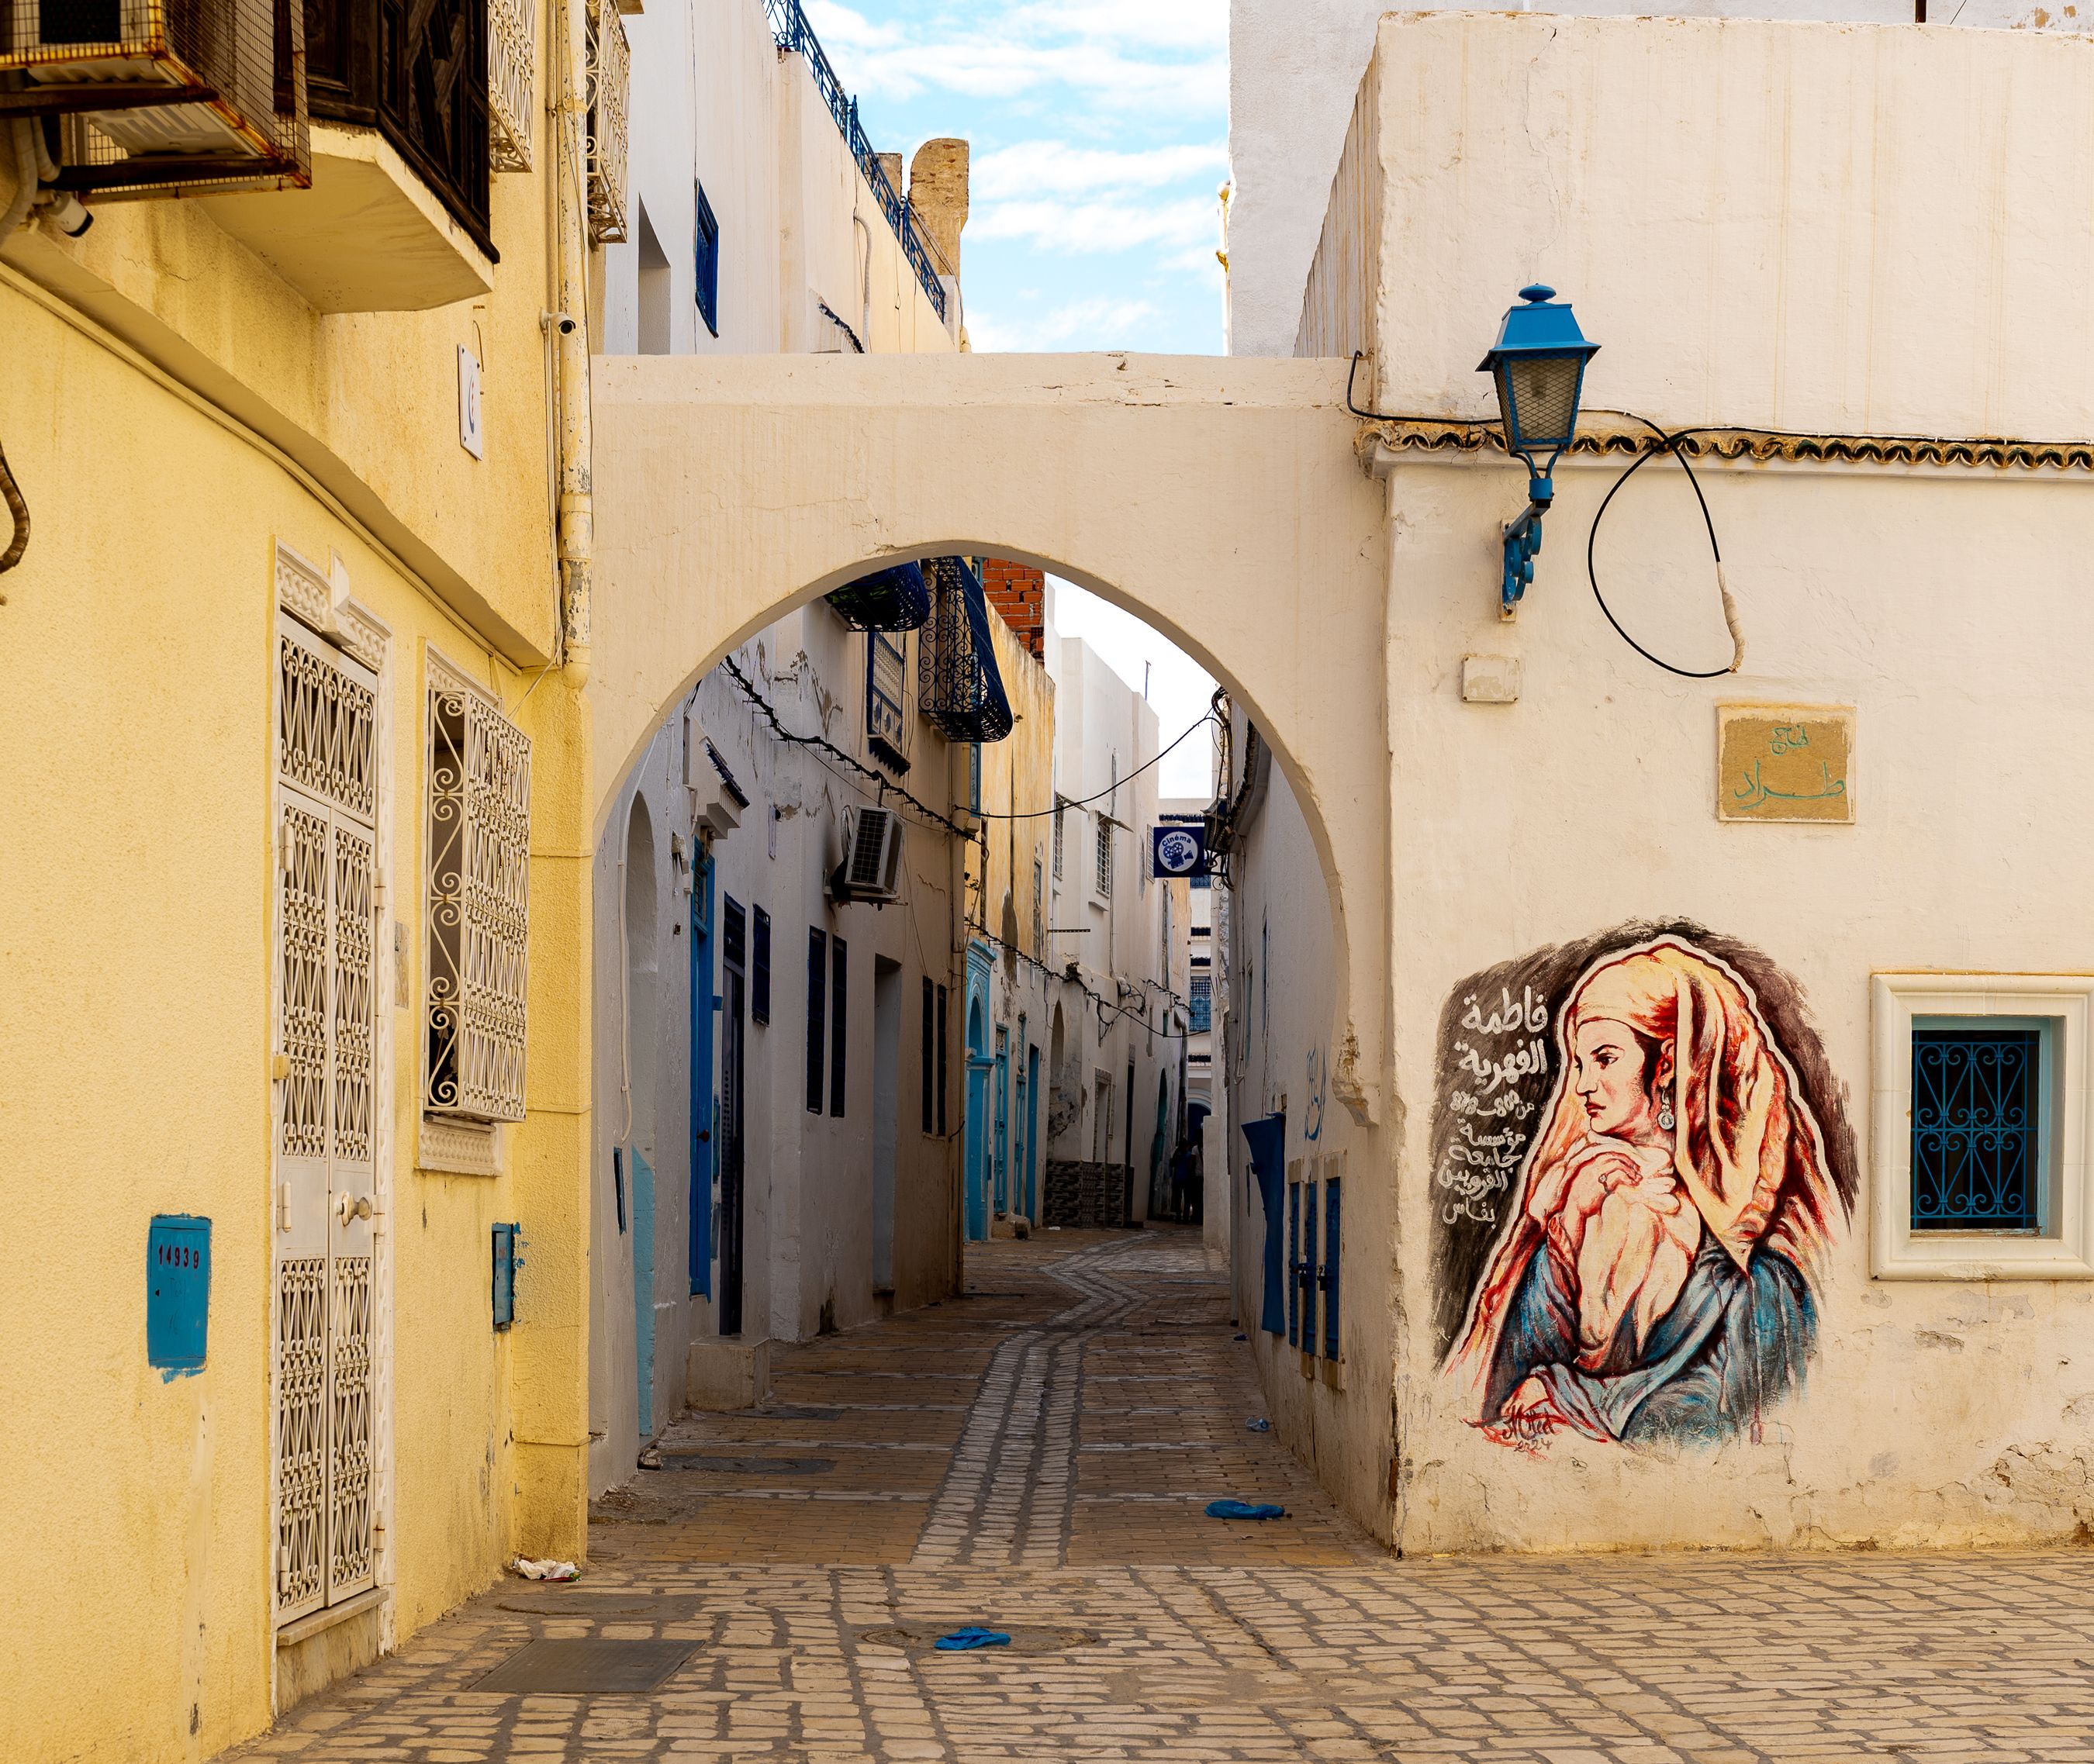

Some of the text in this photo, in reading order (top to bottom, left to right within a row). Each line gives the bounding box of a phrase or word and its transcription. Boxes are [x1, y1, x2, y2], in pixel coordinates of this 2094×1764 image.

[1768, 724, 1809, 756] نهج
[1733, 758, 1846, 810] طراد
[1161, 834, 1192, 847] Cinéma
[1461, 985, 1548, 1035] فاطمة
[1453, 1037, 1548, 1095] الفهرية
[1515, 1099, 1535, 1120] من
[1457, 1117, 1526, 1155] مؤسسة
[1447, 1137, 1522, 1174] جامعة
[1436, 1159, 1508, 1201] القرويين
[1442, 1196, 1496, 1230] بفاس
[158, 1244, 199, 1269] 14939
